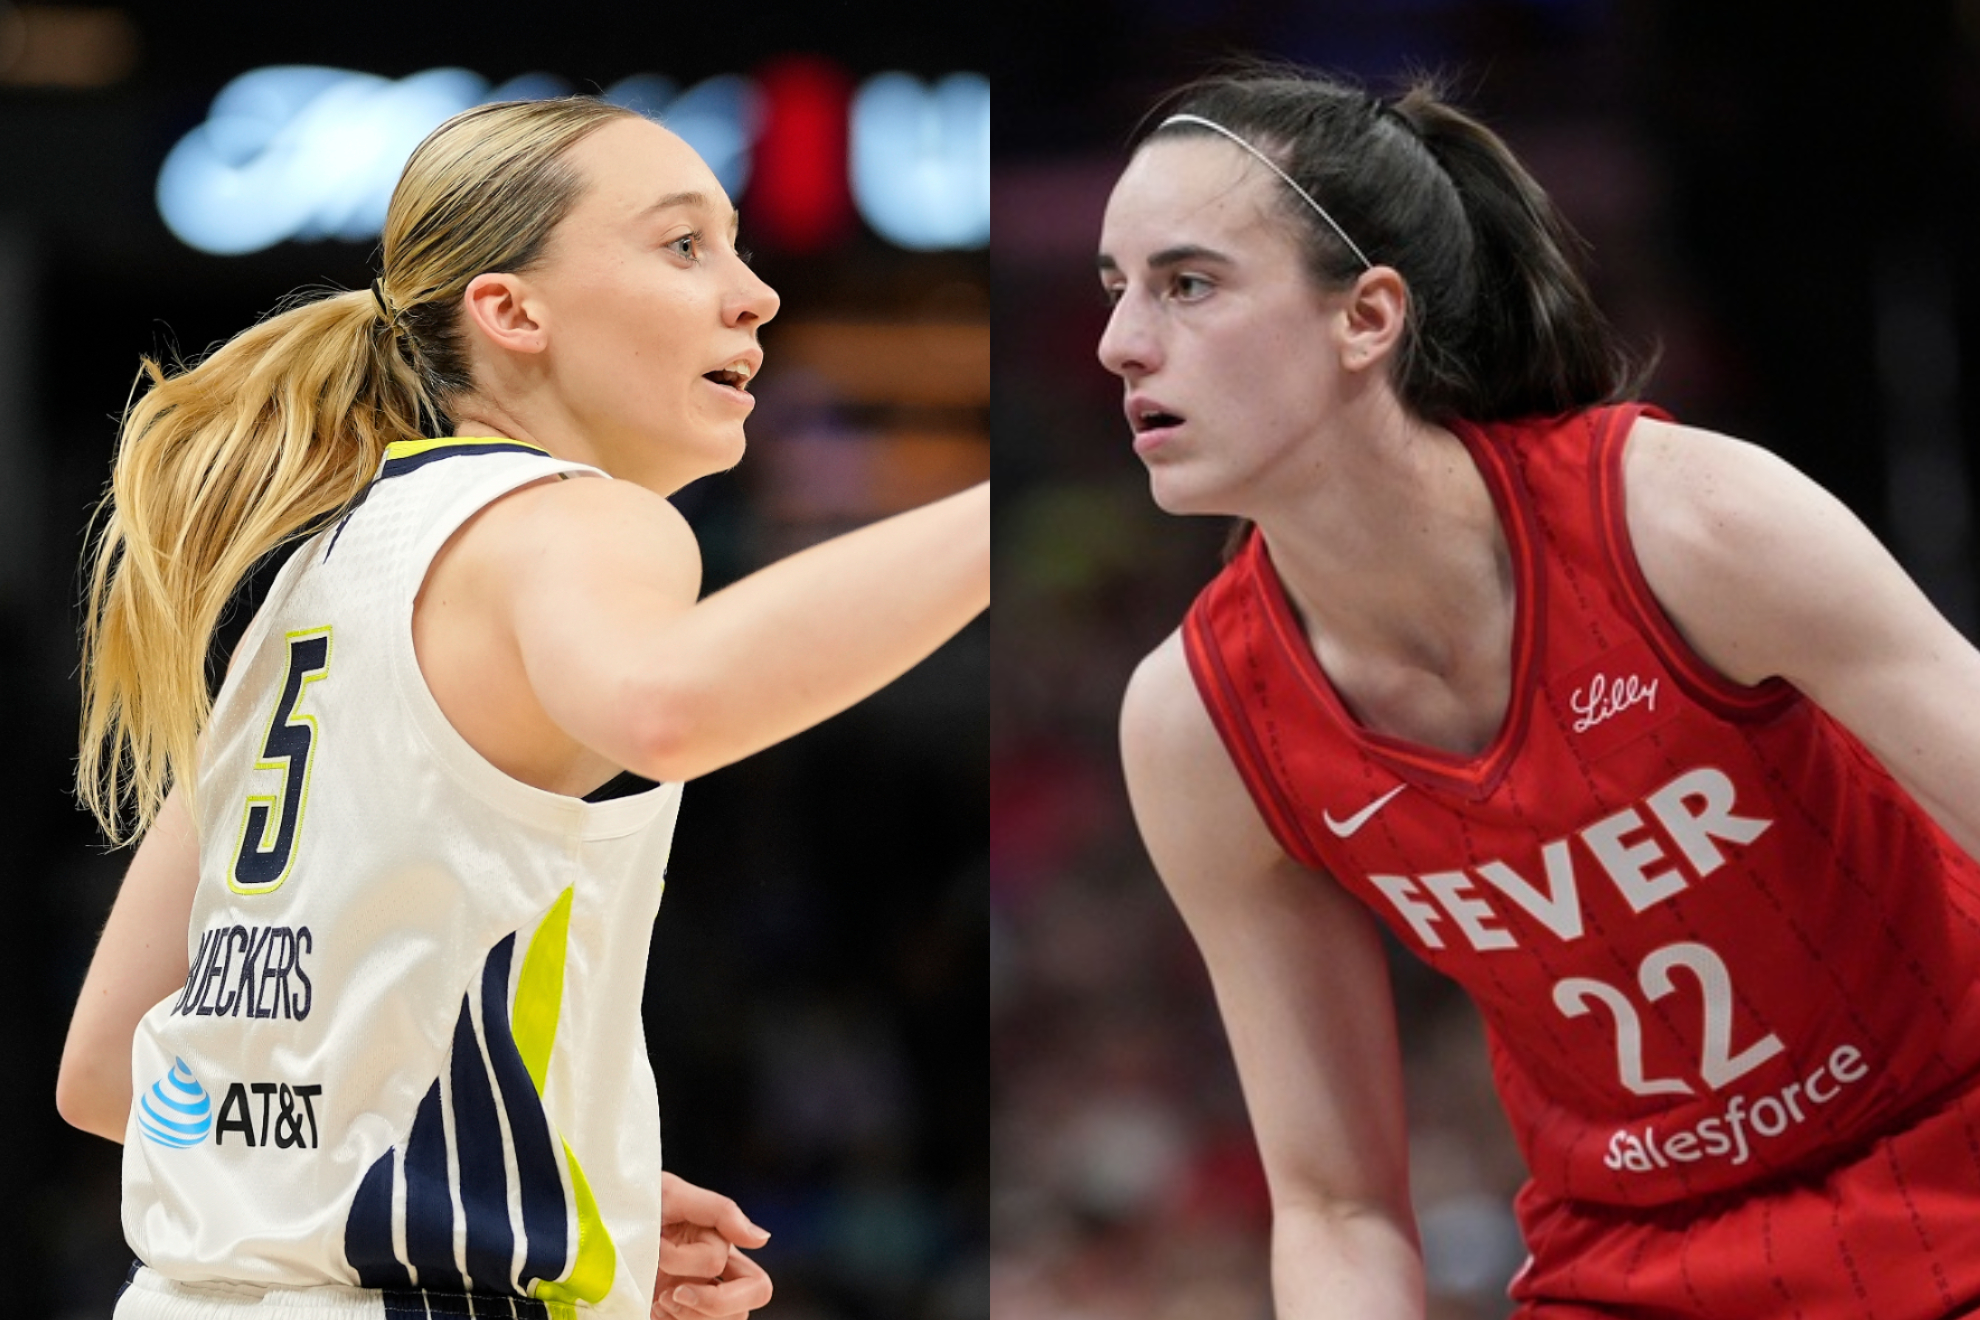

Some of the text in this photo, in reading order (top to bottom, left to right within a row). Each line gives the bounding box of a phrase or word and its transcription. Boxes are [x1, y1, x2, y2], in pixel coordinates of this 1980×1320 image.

[227, 624, 333, 895] 5
[1570, 673, 1658, 733] Lilly
[1368, 767, 1774, 951] FEVER
[1552, 941, 1786, 1096] 22
[216, 1082, 322, 1149] AT&T
[1604, 1043, 1868, 1171] salesforce
